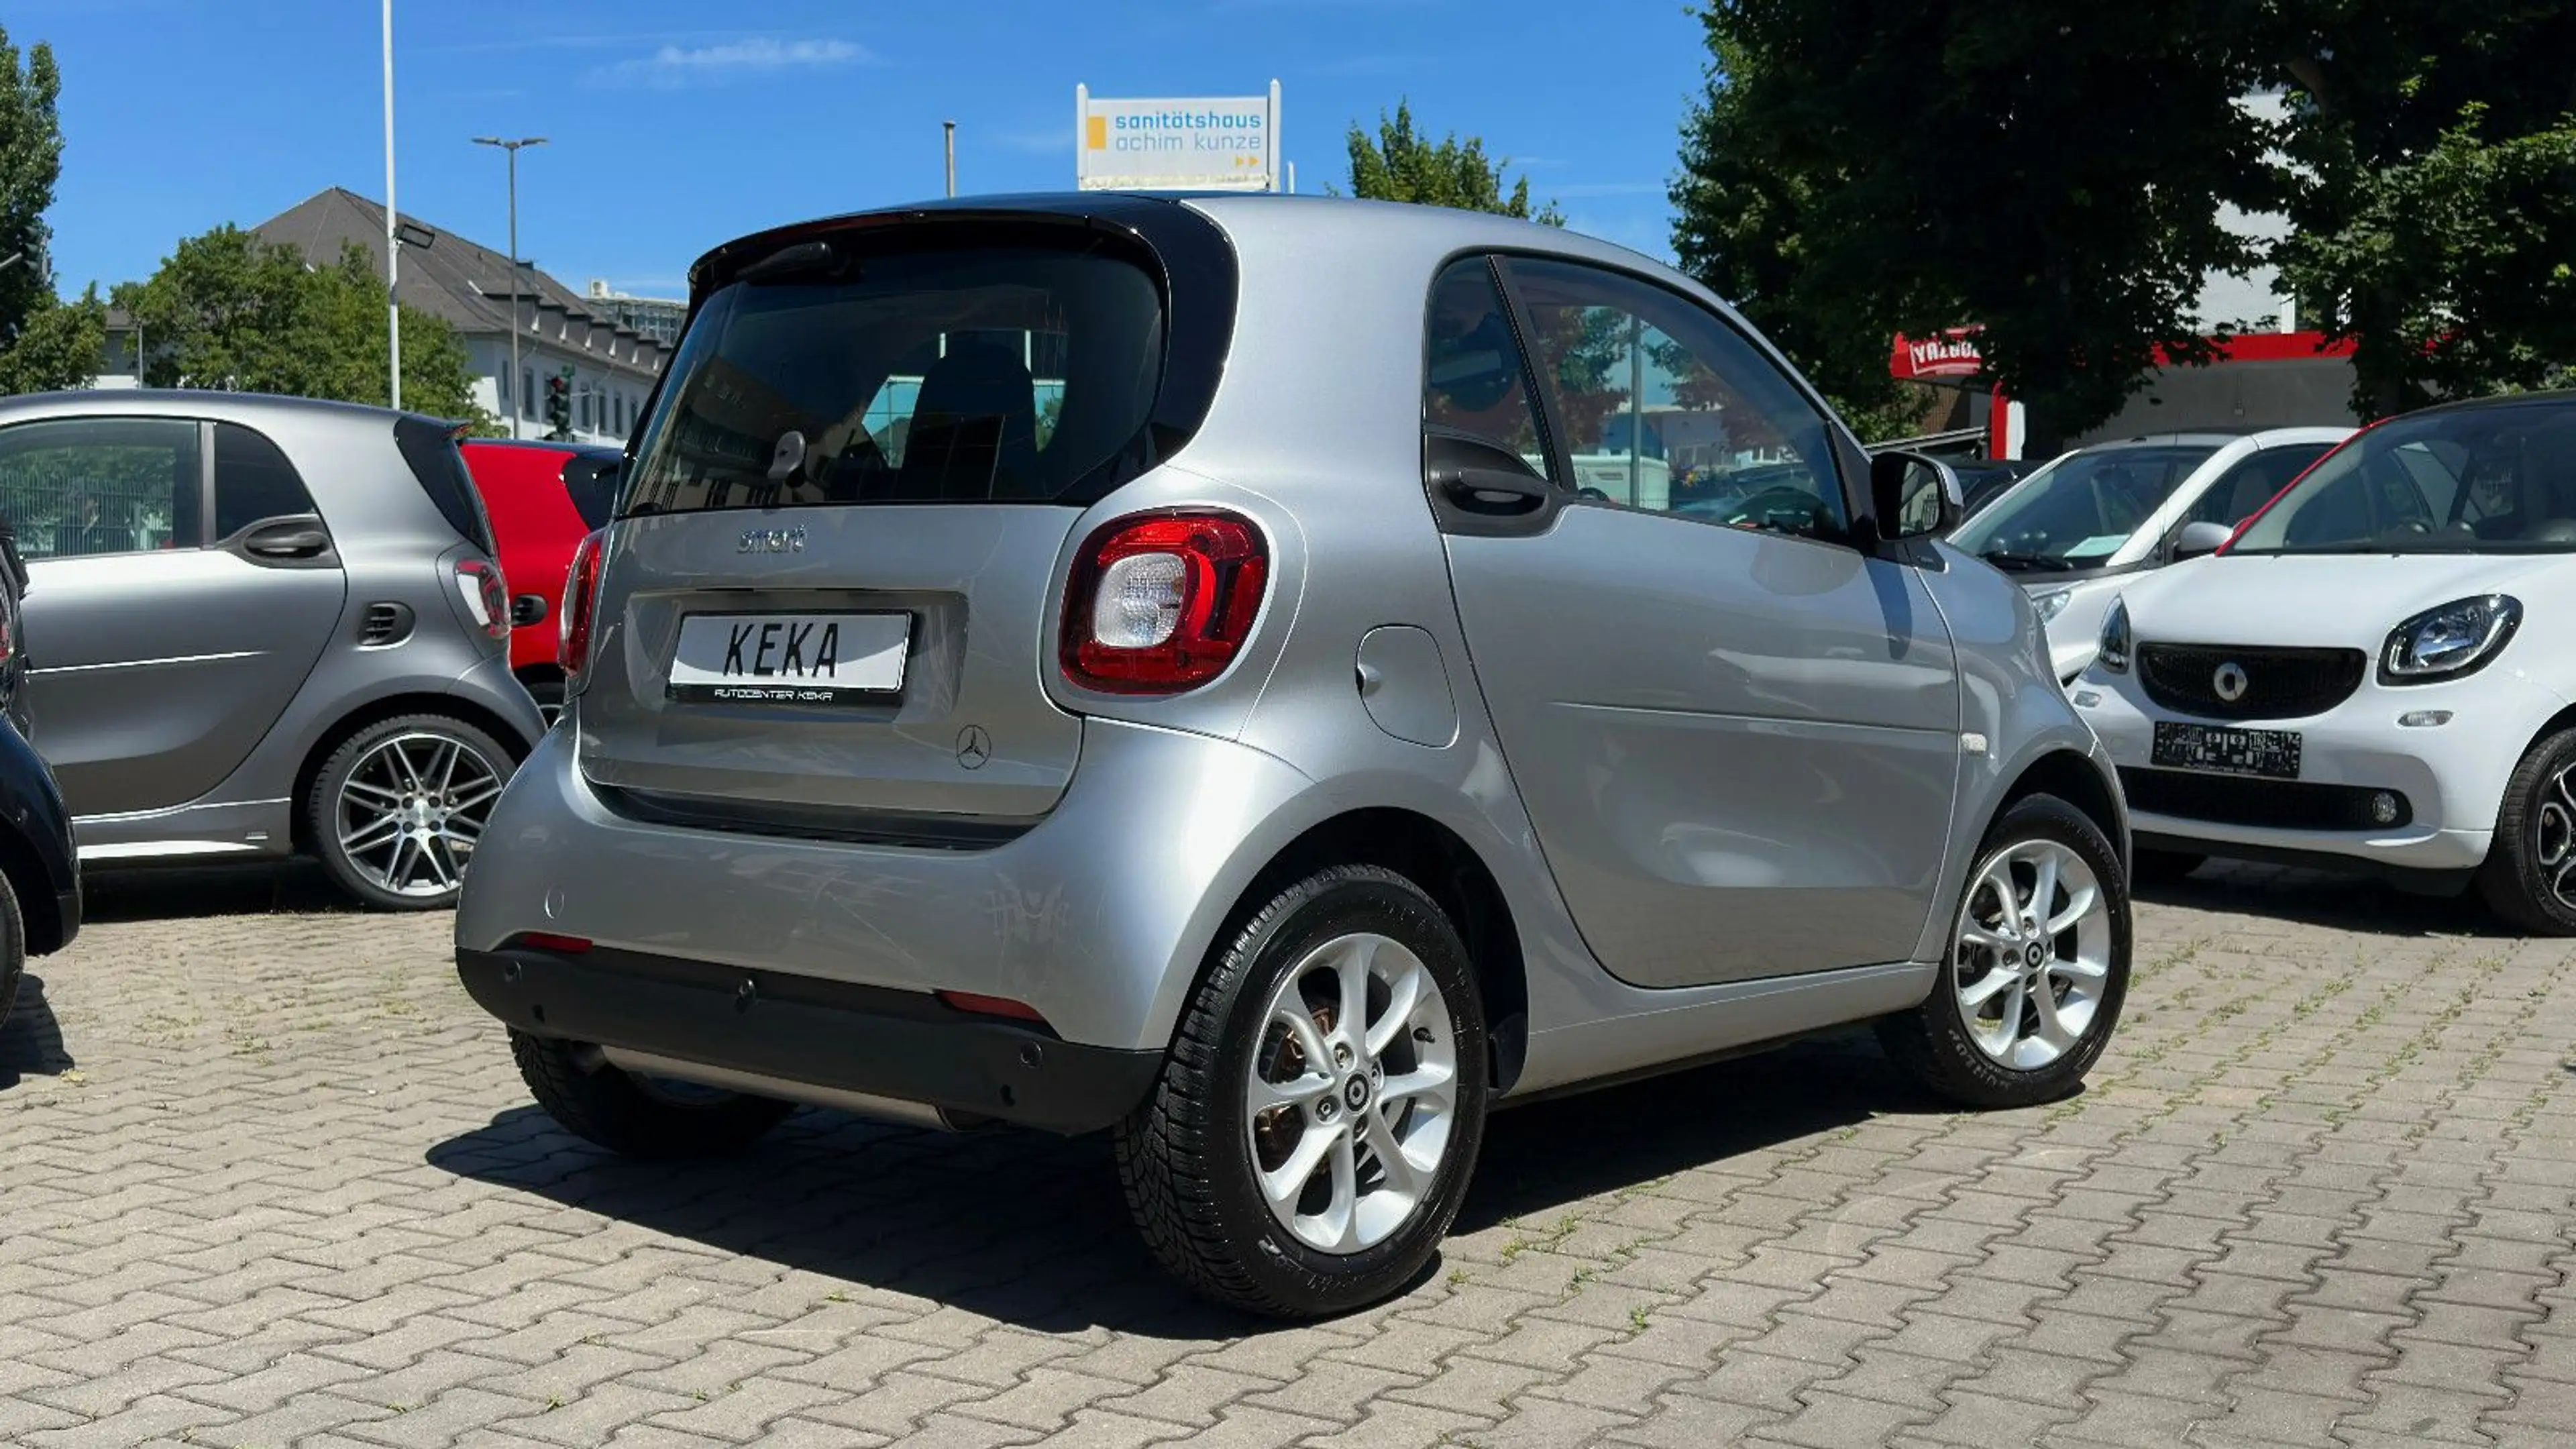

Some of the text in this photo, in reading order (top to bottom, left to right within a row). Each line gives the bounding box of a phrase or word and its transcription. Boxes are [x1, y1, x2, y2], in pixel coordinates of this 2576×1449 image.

[1115, 111, 1261, 130] sanitätshaus
[1115, 131, 1261, 152] achim kunze
[723, 623, 839, 678] KEKA
